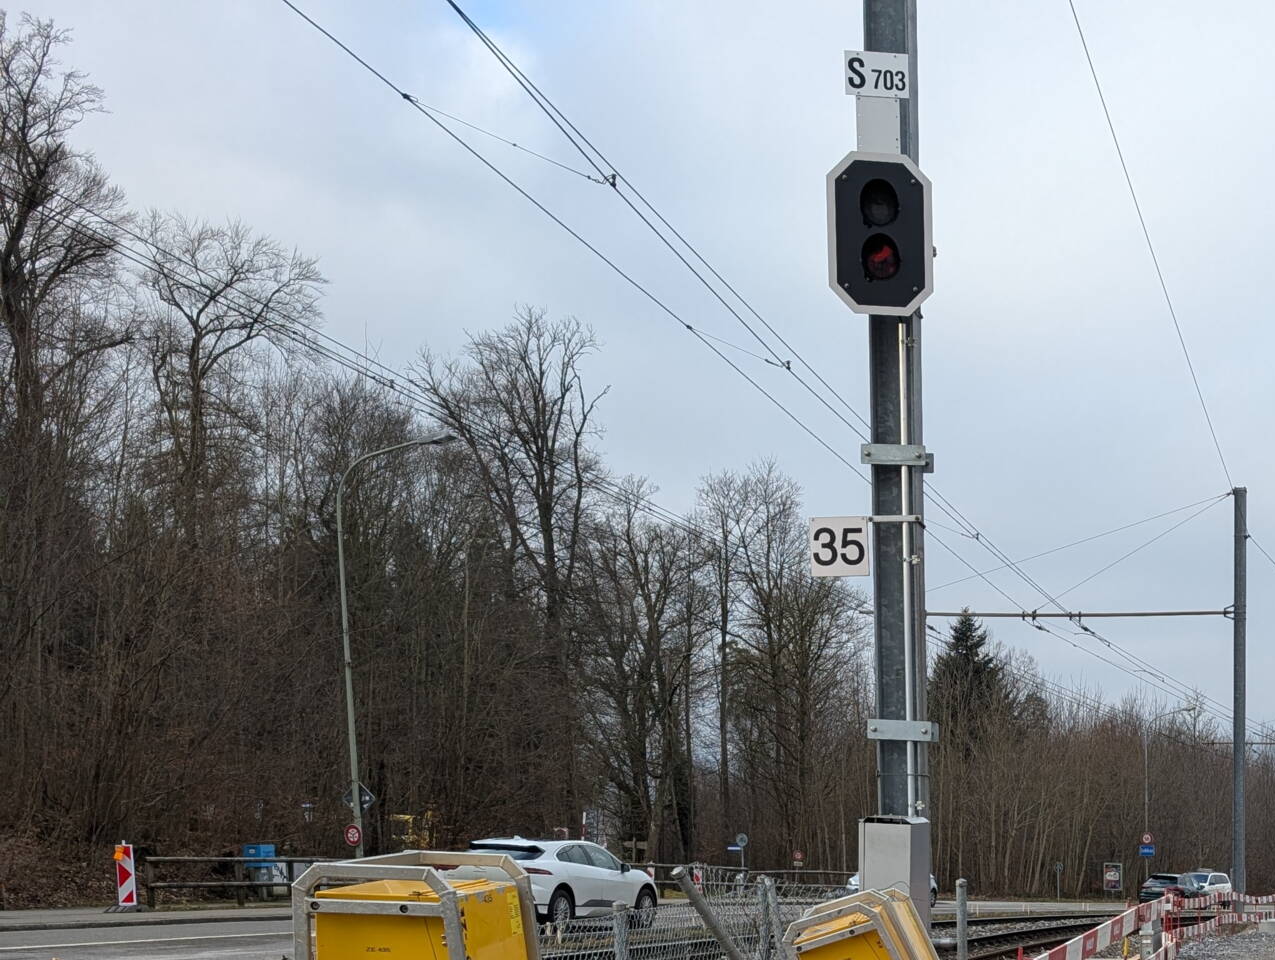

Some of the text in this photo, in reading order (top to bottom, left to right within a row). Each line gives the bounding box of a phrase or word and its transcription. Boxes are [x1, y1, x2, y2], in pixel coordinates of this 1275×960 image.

[847, 57, 906, 91] S 703
[812, 527, 866, 567] 35
